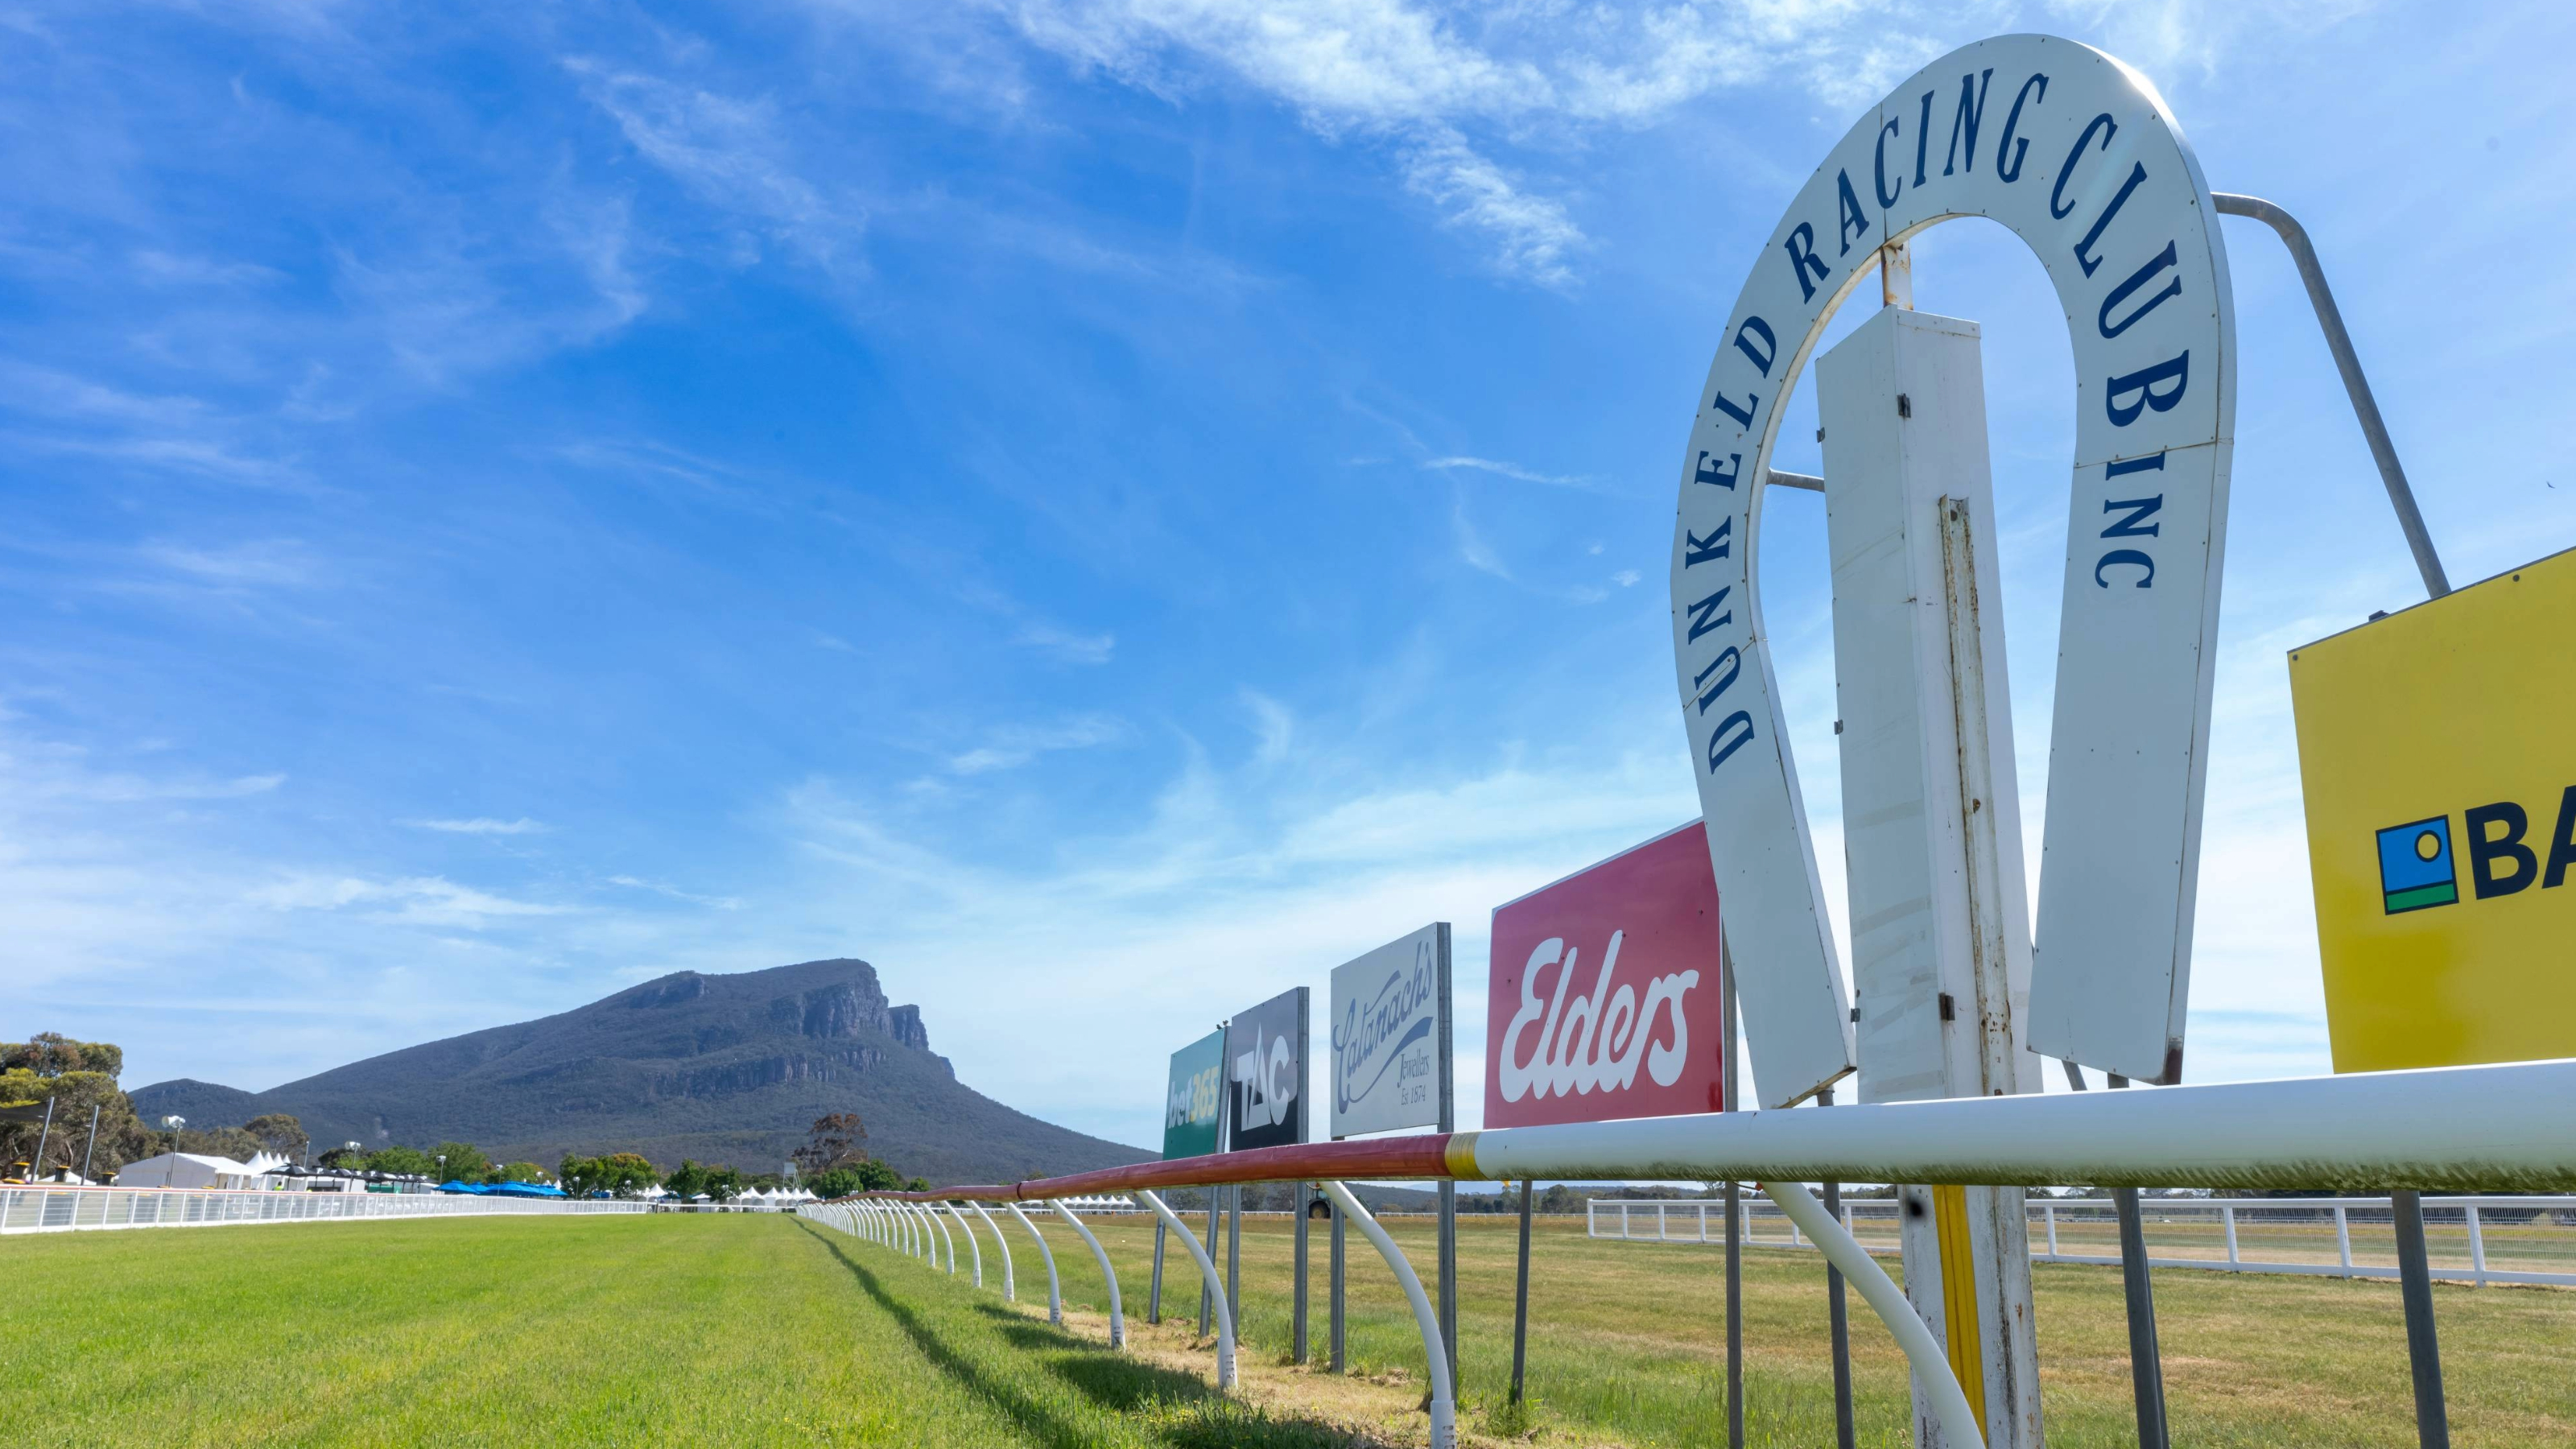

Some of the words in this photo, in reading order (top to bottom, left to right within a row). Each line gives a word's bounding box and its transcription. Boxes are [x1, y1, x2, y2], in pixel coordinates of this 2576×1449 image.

[1784, 68, 2049, 305] RACING
[2050, 113, 2189, 427] CLUB
[1685, 316, 1777, 774] DUNKELD
[2095, 451, 2165, 588] INC
[1236, 1021, 1290, 1132] TAC
[1332, 939, 1433, 1115] Catanach's
[1397, 1047, 1430, 1088] Jewellers
[1410, 1084, 1426, 1104] 1874
[1499, 929, 1699, 1104] Elders
[1167, 1066, 1219, 1129] bet365
